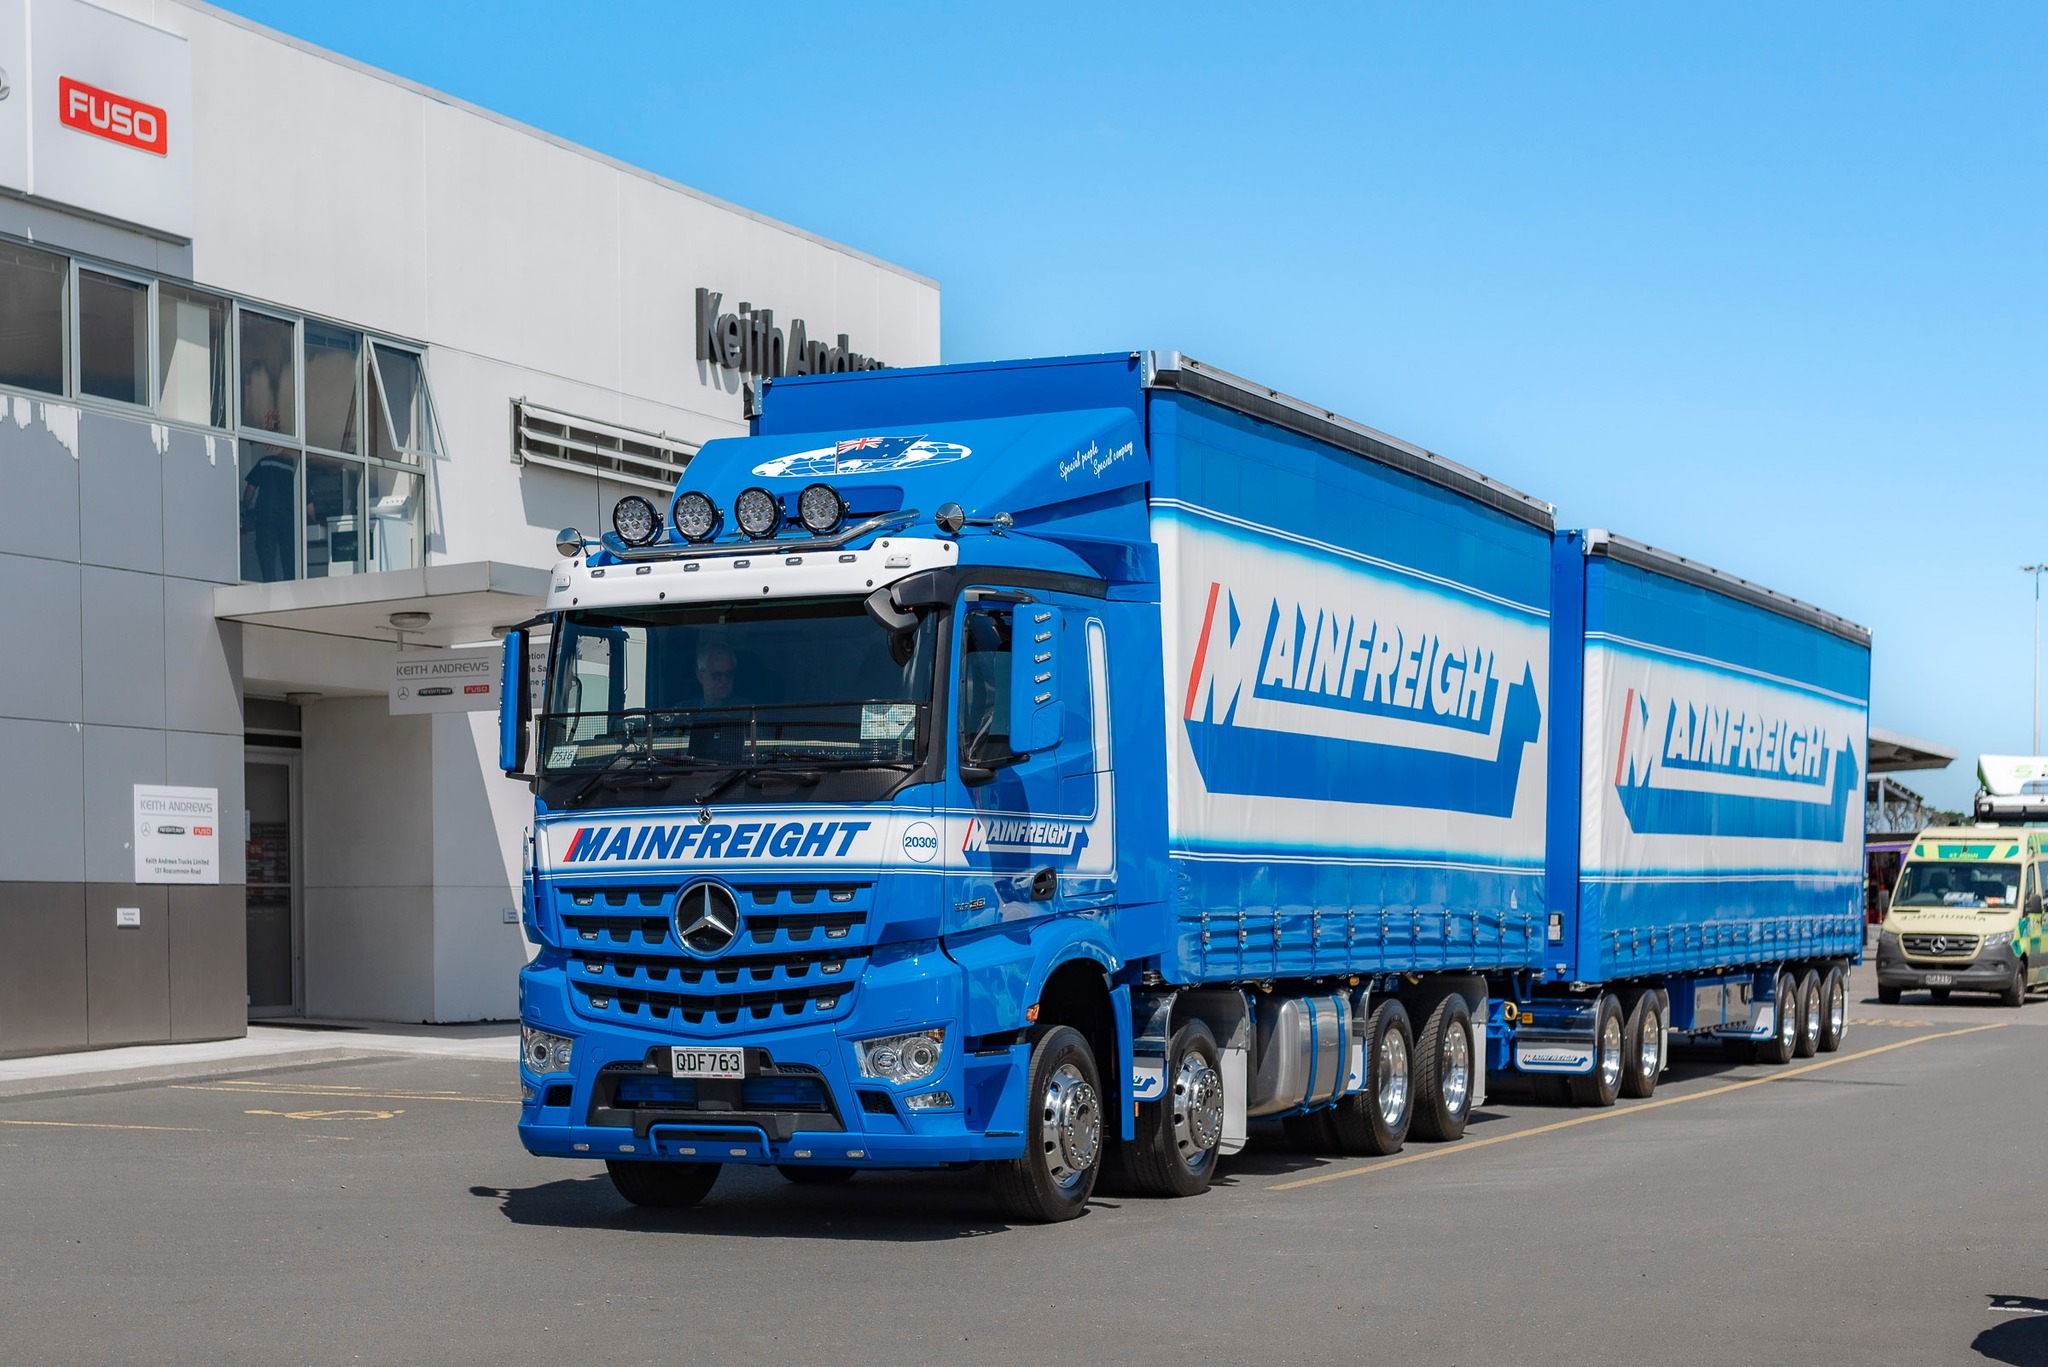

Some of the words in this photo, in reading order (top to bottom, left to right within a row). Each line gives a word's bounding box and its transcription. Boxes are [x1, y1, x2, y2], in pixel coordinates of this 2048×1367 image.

[69, 88, 157, 143] FUSO
[695, 287, 784, 378] Keith
[1060, 450, 1081, 482] Special
[1081, 440, 1099, 470] people
[1093, 448, 1113, 479] Special
[396, 664, 428, 676] KEITH
[431, 661, 490, 674] ANDREWS
[1184, 581, 1525, 763] MAINFREIGHT
[465, 685, 489, 693] FUSO
[552, 751, 574, 763] 7516
[1615, 688, 1846, 805] MAINFREIGHT
[140, 799, 166, 811] KEITH
[168, 801, 213, 813] ANDREWS
[562, 821, 872, 863] MAINFREIGHT
[904, 836, 937, 848] 20309
[962, 817, 1086, 857] MAINFREIGHT
[145, 857, 158, 866] Keith
[158, 857, 178, 866] Andrews
[178, 857, 192, 866] Trucks
[193, 858, 209, 867] Limited
[190, 867, 202, 876] Road
[676, 1053, 740, 1072] QDF763
